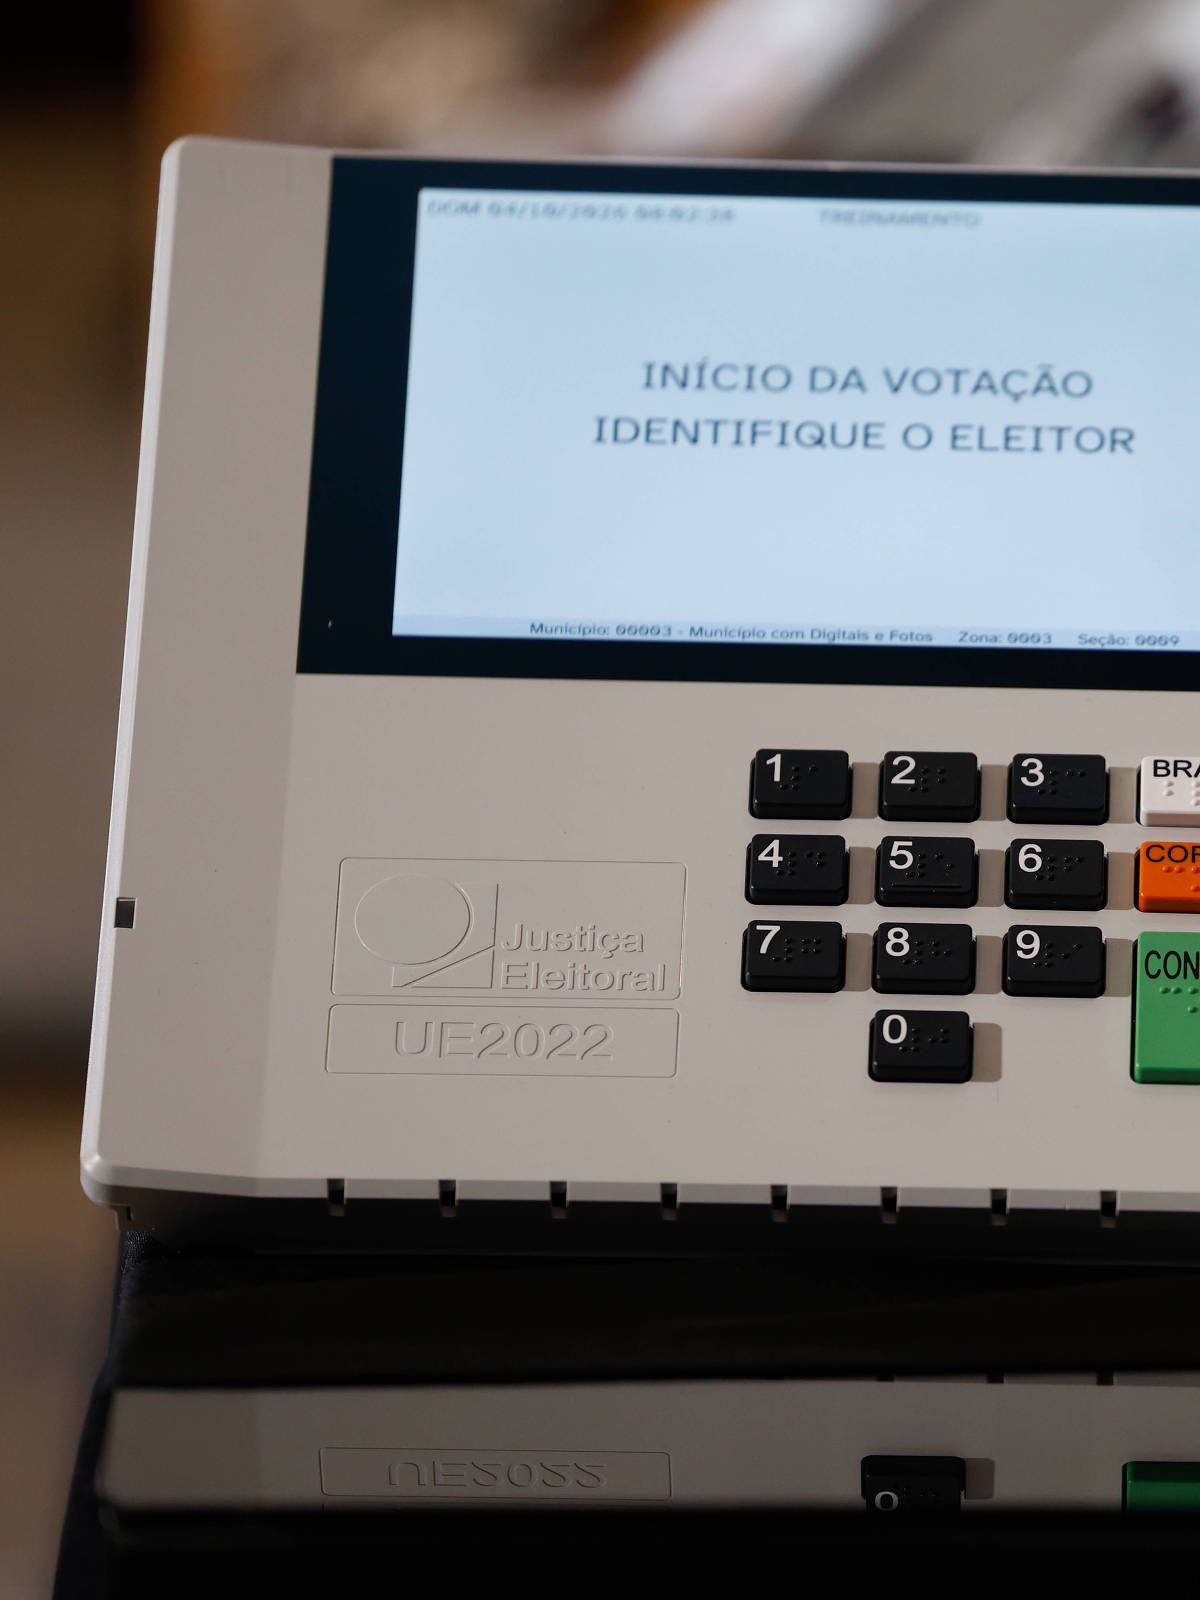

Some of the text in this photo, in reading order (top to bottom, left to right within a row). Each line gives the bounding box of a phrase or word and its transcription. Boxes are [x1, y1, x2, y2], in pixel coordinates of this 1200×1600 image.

[641, 356, 1093, 402] INÍCIO DA VOTAÇÃO
[593, 416, 1137, 454] IDENTIFIQUE O ELEITOR
[616, 623, 672, 637] 00003
[688, 625, 766, 640] Município
[771, 629, 804, 640] com
[810, 627, 869, 643] Digitais
[875, 631, 884, 641] e
[889, 629, 933, 642] Fotos
[958, 631, 1002, 644] Zona:
[1007, 632, 1052, 645] 0003
[1078, 633, 1130, 648] Seção:
[1135, 634, 1180, 647] 0009
[766, 753, 782, 782] 1
[890, 755, 916, 785] 2
[1020, 758, 1045, 787] 3
[757, 839, 783, 868] 4
[888, 840, 914, 870] 5
[1018, 843, 1042, 873] 6
[500, 923, 645, 959] Justiça
[755, 924, 781, 954] 7
[885, 927, 910, 957] 8
[1016, 930, 1041, 959] 9
[500, 961, 666, 992] Eleitoral
[394, 1020, 615, 1061] UE2022
[882, 1014, 908, 1044] 0
